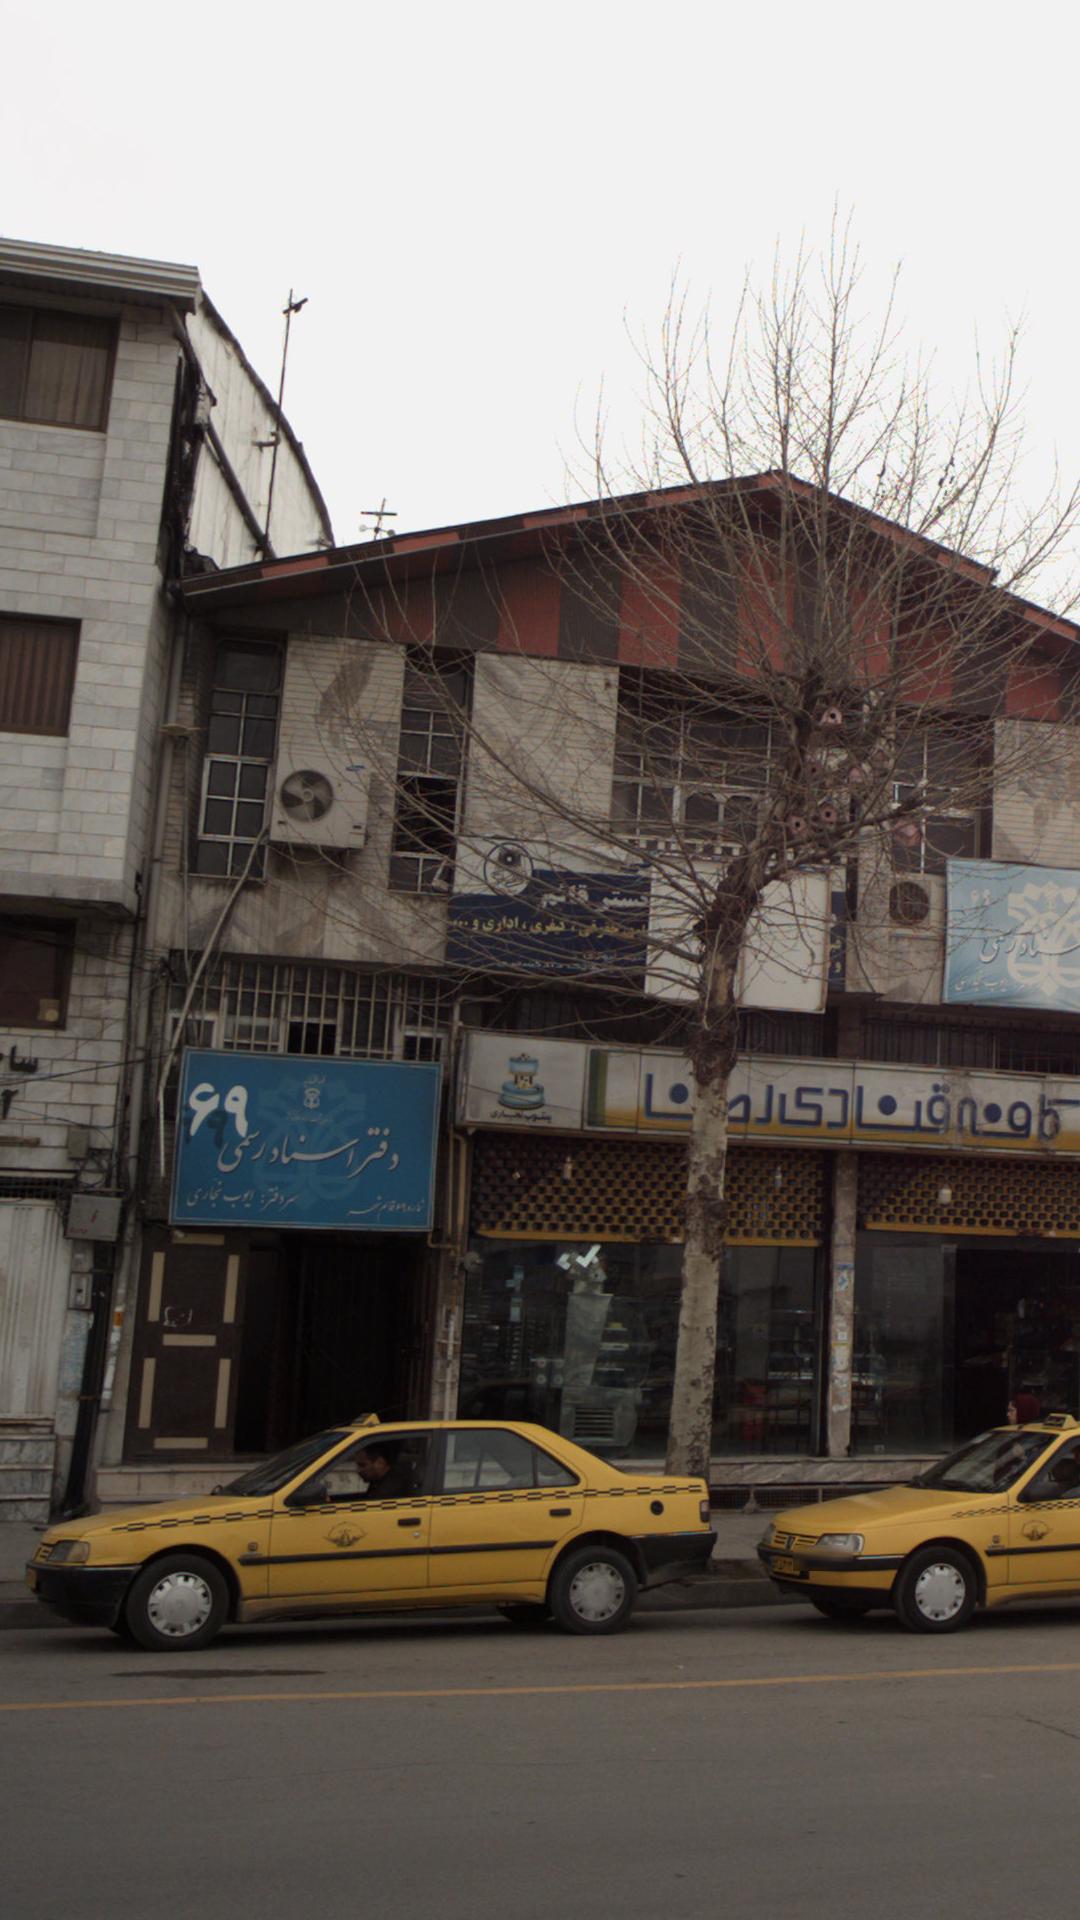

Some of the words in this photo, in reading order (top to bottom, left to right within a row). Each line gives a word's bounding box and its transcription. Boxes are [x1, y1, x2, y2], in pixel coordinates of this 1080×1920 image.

[482, 915, 519, 932] اداری
[1019, 931, 1080, 958] سناد
[188, 1082, 249, 1138] ۶۹
[216, 1129, 266, 1174] رسمی
[269, 1135, 361, 1167] اسناد
[347, 1127, 400, 1180] دفتر
[223, 1189, 255, 1209] ایوب
